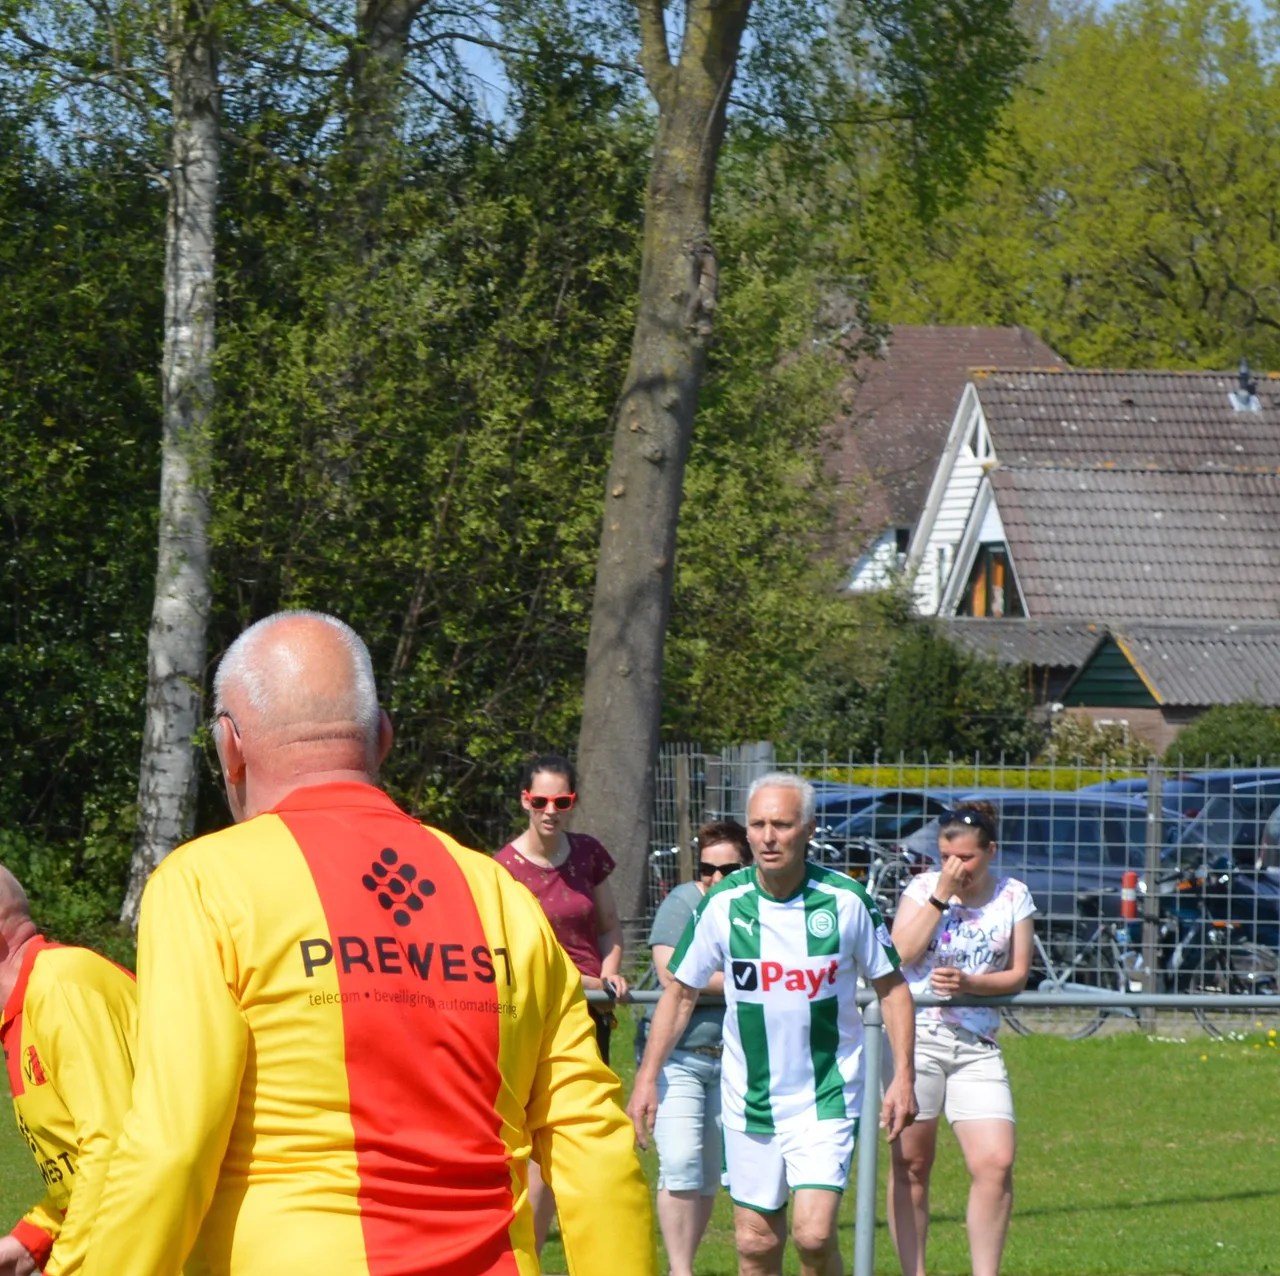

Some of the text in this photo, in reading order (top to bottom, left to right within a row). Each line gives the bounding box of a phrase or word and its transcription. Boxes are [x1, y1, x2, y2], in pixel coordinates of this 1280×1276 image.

[299, 936, 512, 986] PREWEST
[760, 959, 838, 999] Payt
[308, 990, 360, 1006] telecom
